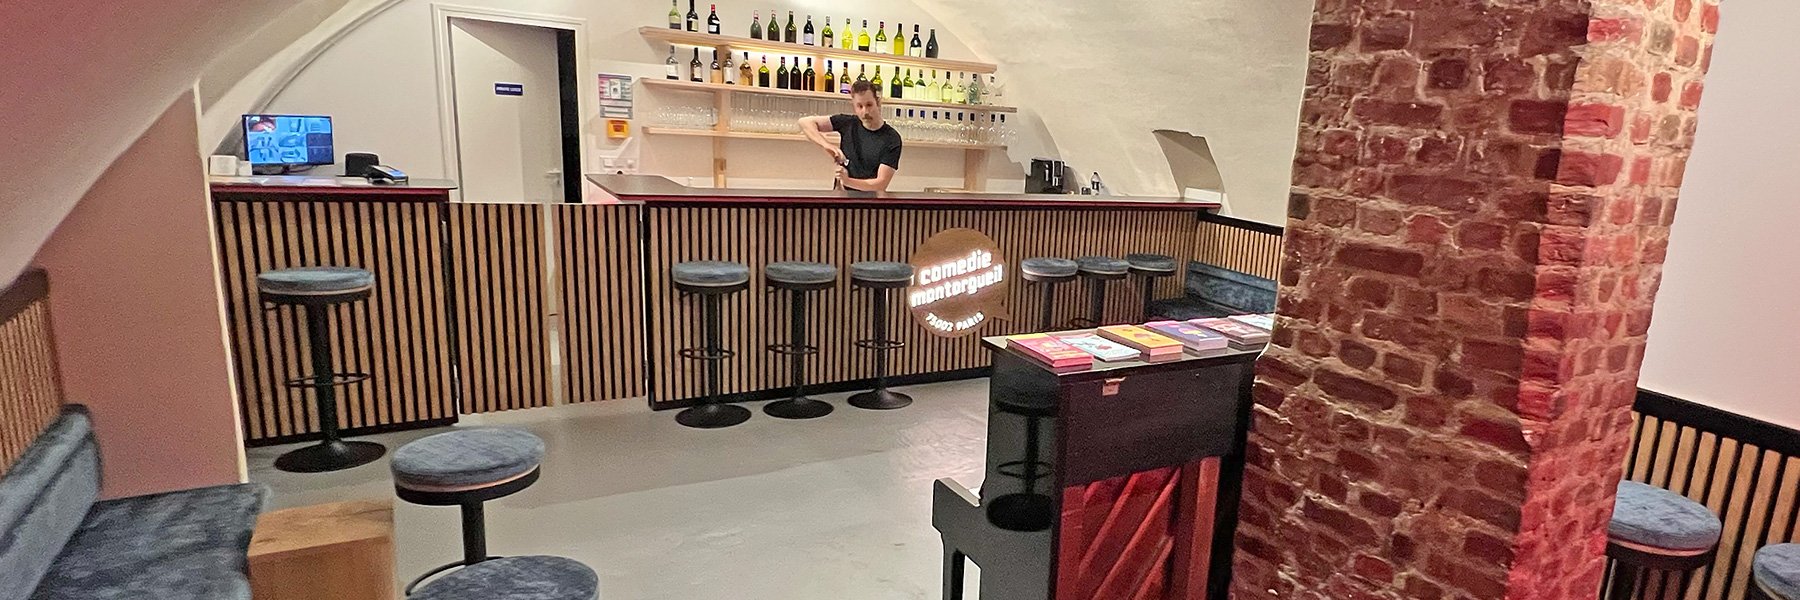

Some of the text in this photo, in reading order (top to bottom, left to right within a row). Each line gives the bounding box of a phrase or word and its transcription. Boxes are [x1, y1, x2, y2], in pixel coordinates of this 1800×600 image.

[920, 249, 992, 285] comedie
[911, 264, 1003, 307] montorgueil
[926, 311, 984, 332] 75002 PARIS
